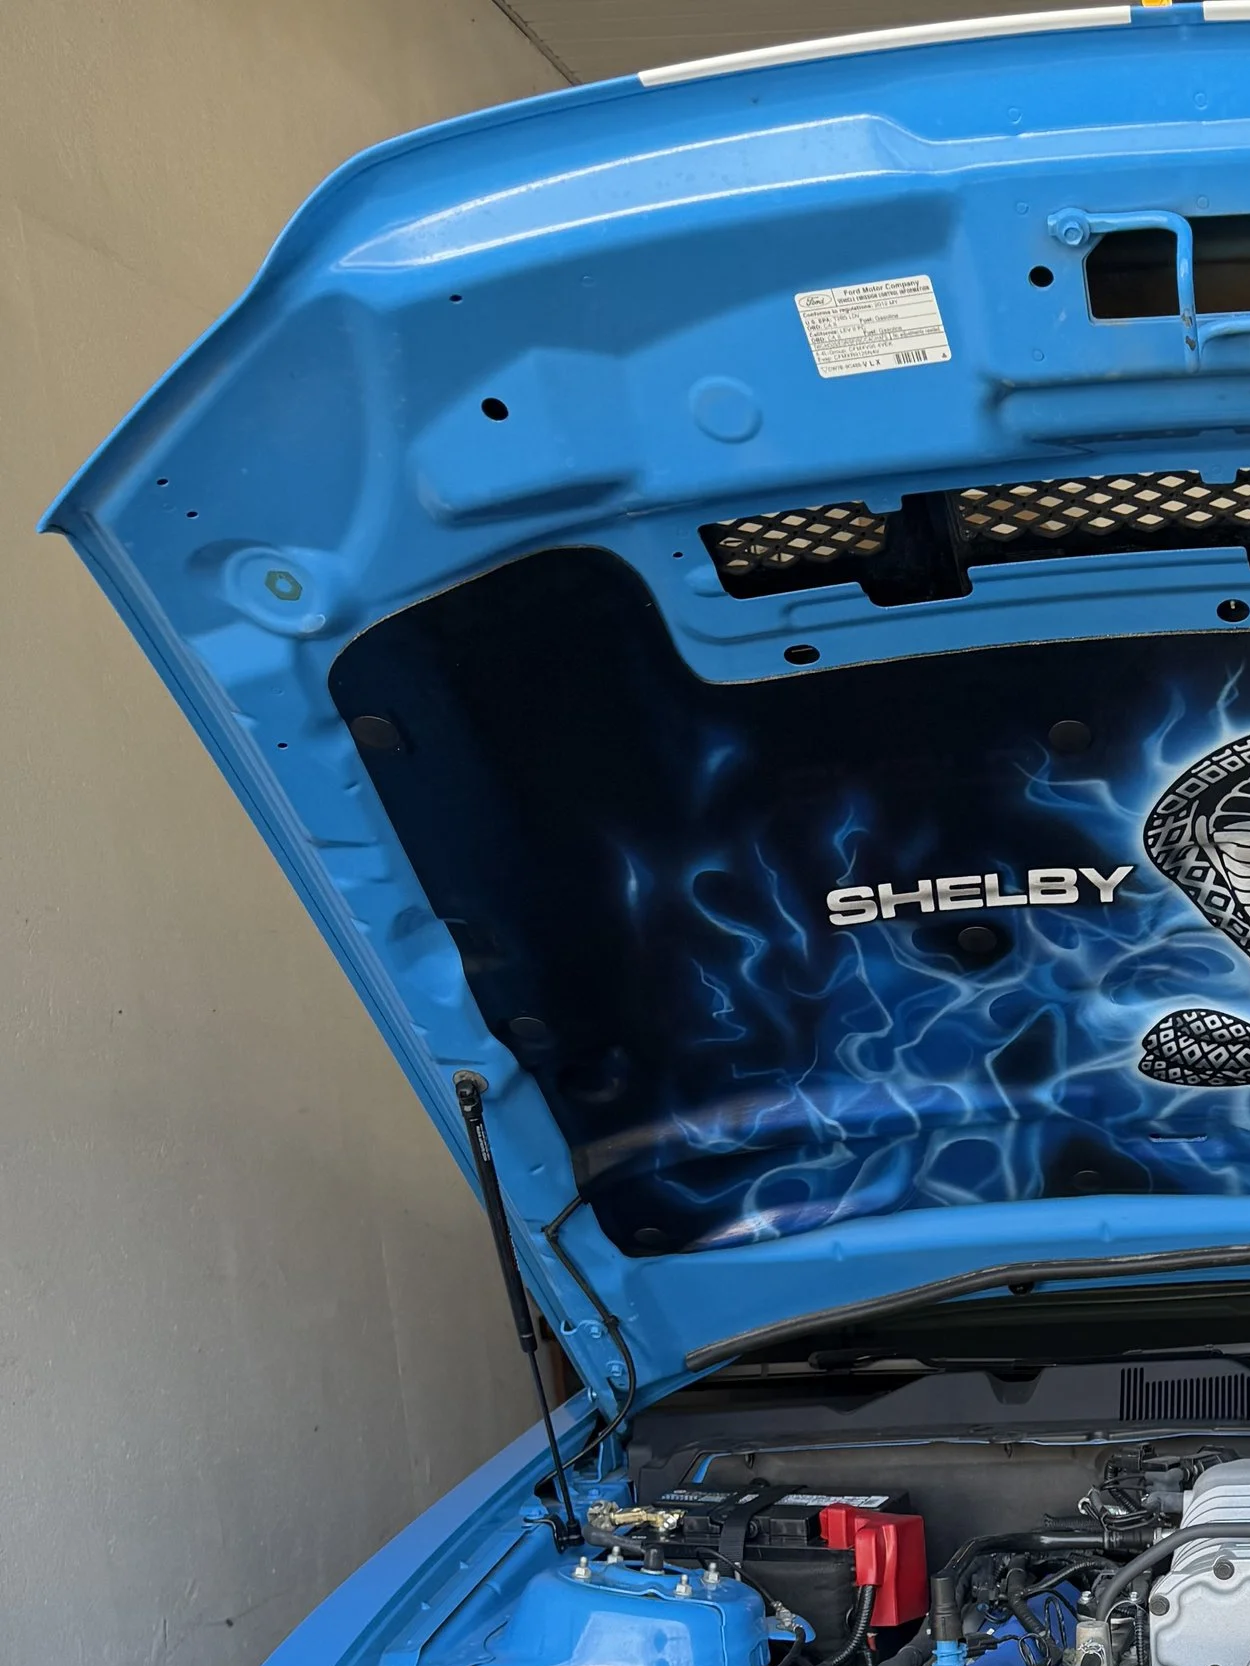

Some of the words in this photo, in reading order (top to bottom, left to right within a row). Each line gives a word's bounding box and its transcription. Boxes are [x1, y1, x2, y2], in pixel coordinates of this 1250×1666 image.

[862, 285, 883, 293] Motor
[885, 280, 919, 292] Company
[804, 295, 825, 307] Ford
[827, 866, 1134, 926] SHELBY
